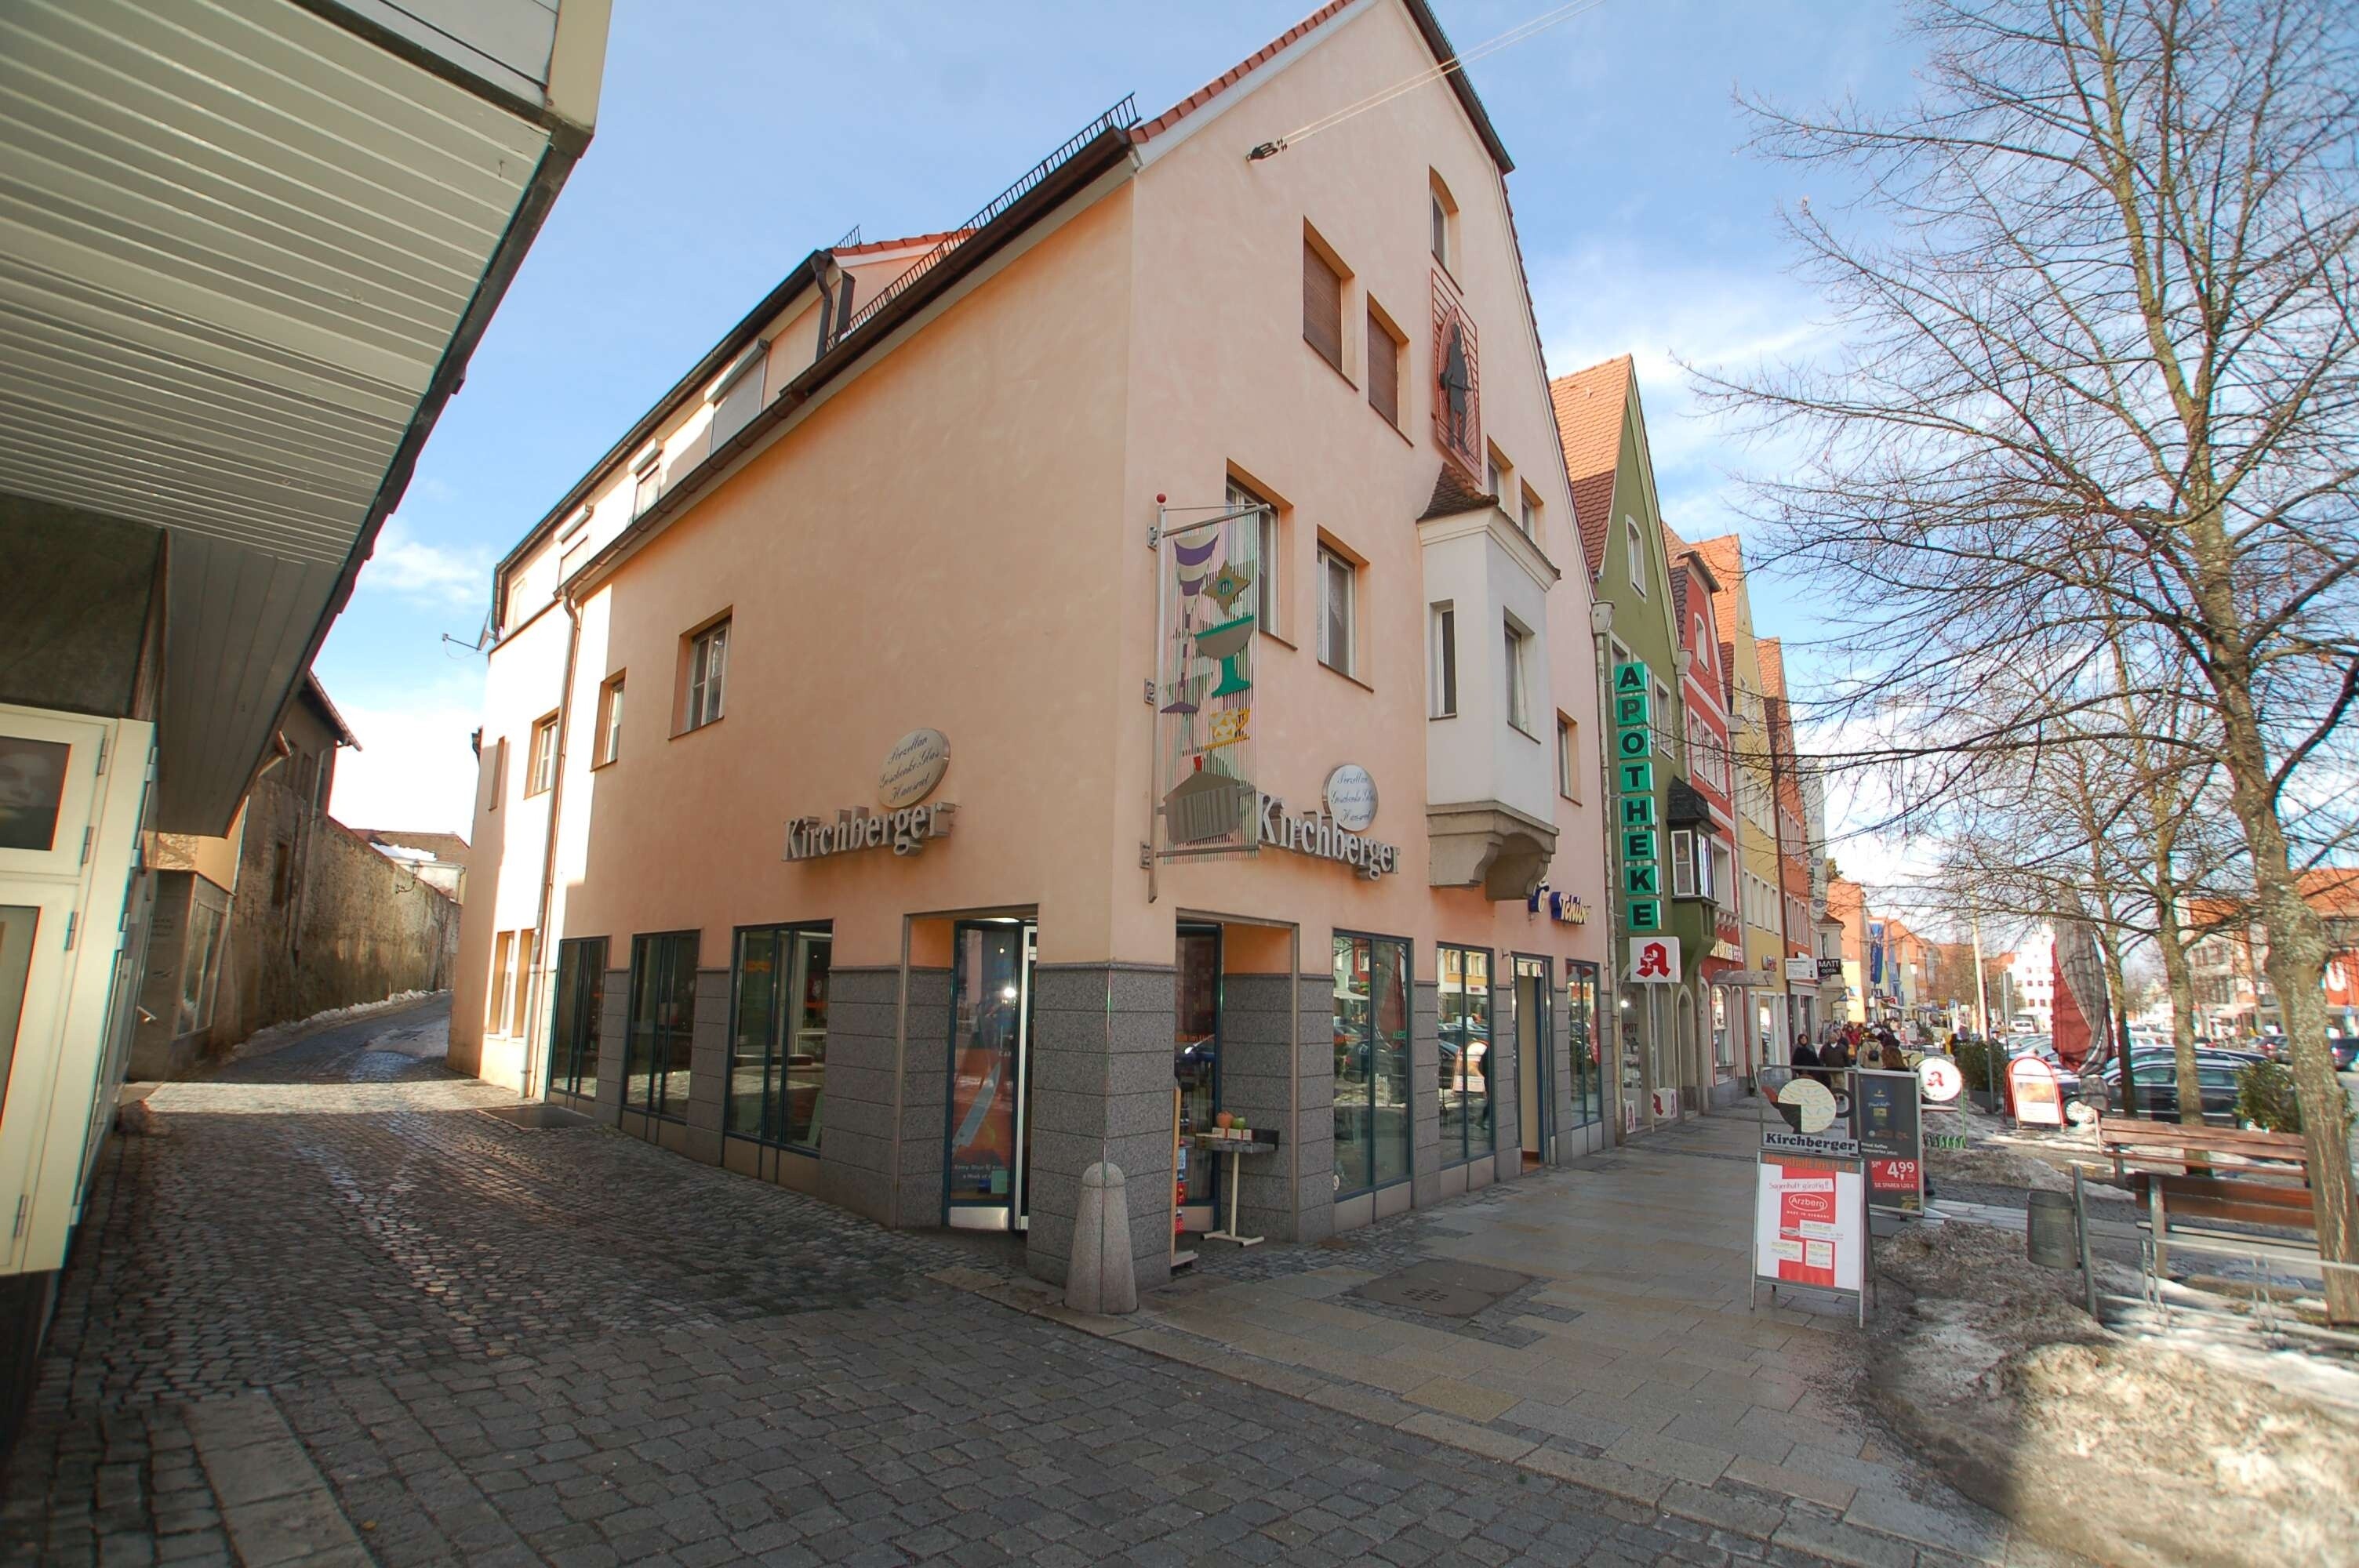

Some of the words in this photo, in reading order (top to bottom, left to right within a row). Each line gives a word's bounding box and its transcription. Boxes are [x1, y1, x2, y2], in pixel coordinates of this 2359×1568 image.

[1619, 666, 1652, 926] APOTHEKE
[783, 804, 944, 862] Kirchberger
[1256, 791, 1400, 880] Kirchberger
[1765, 1132, 1856, 1151] Kirchberger
[1768, 1181, 1801, 1192] Sagenhaft
[1790, 1196, 1825, 1208] Arzberg
